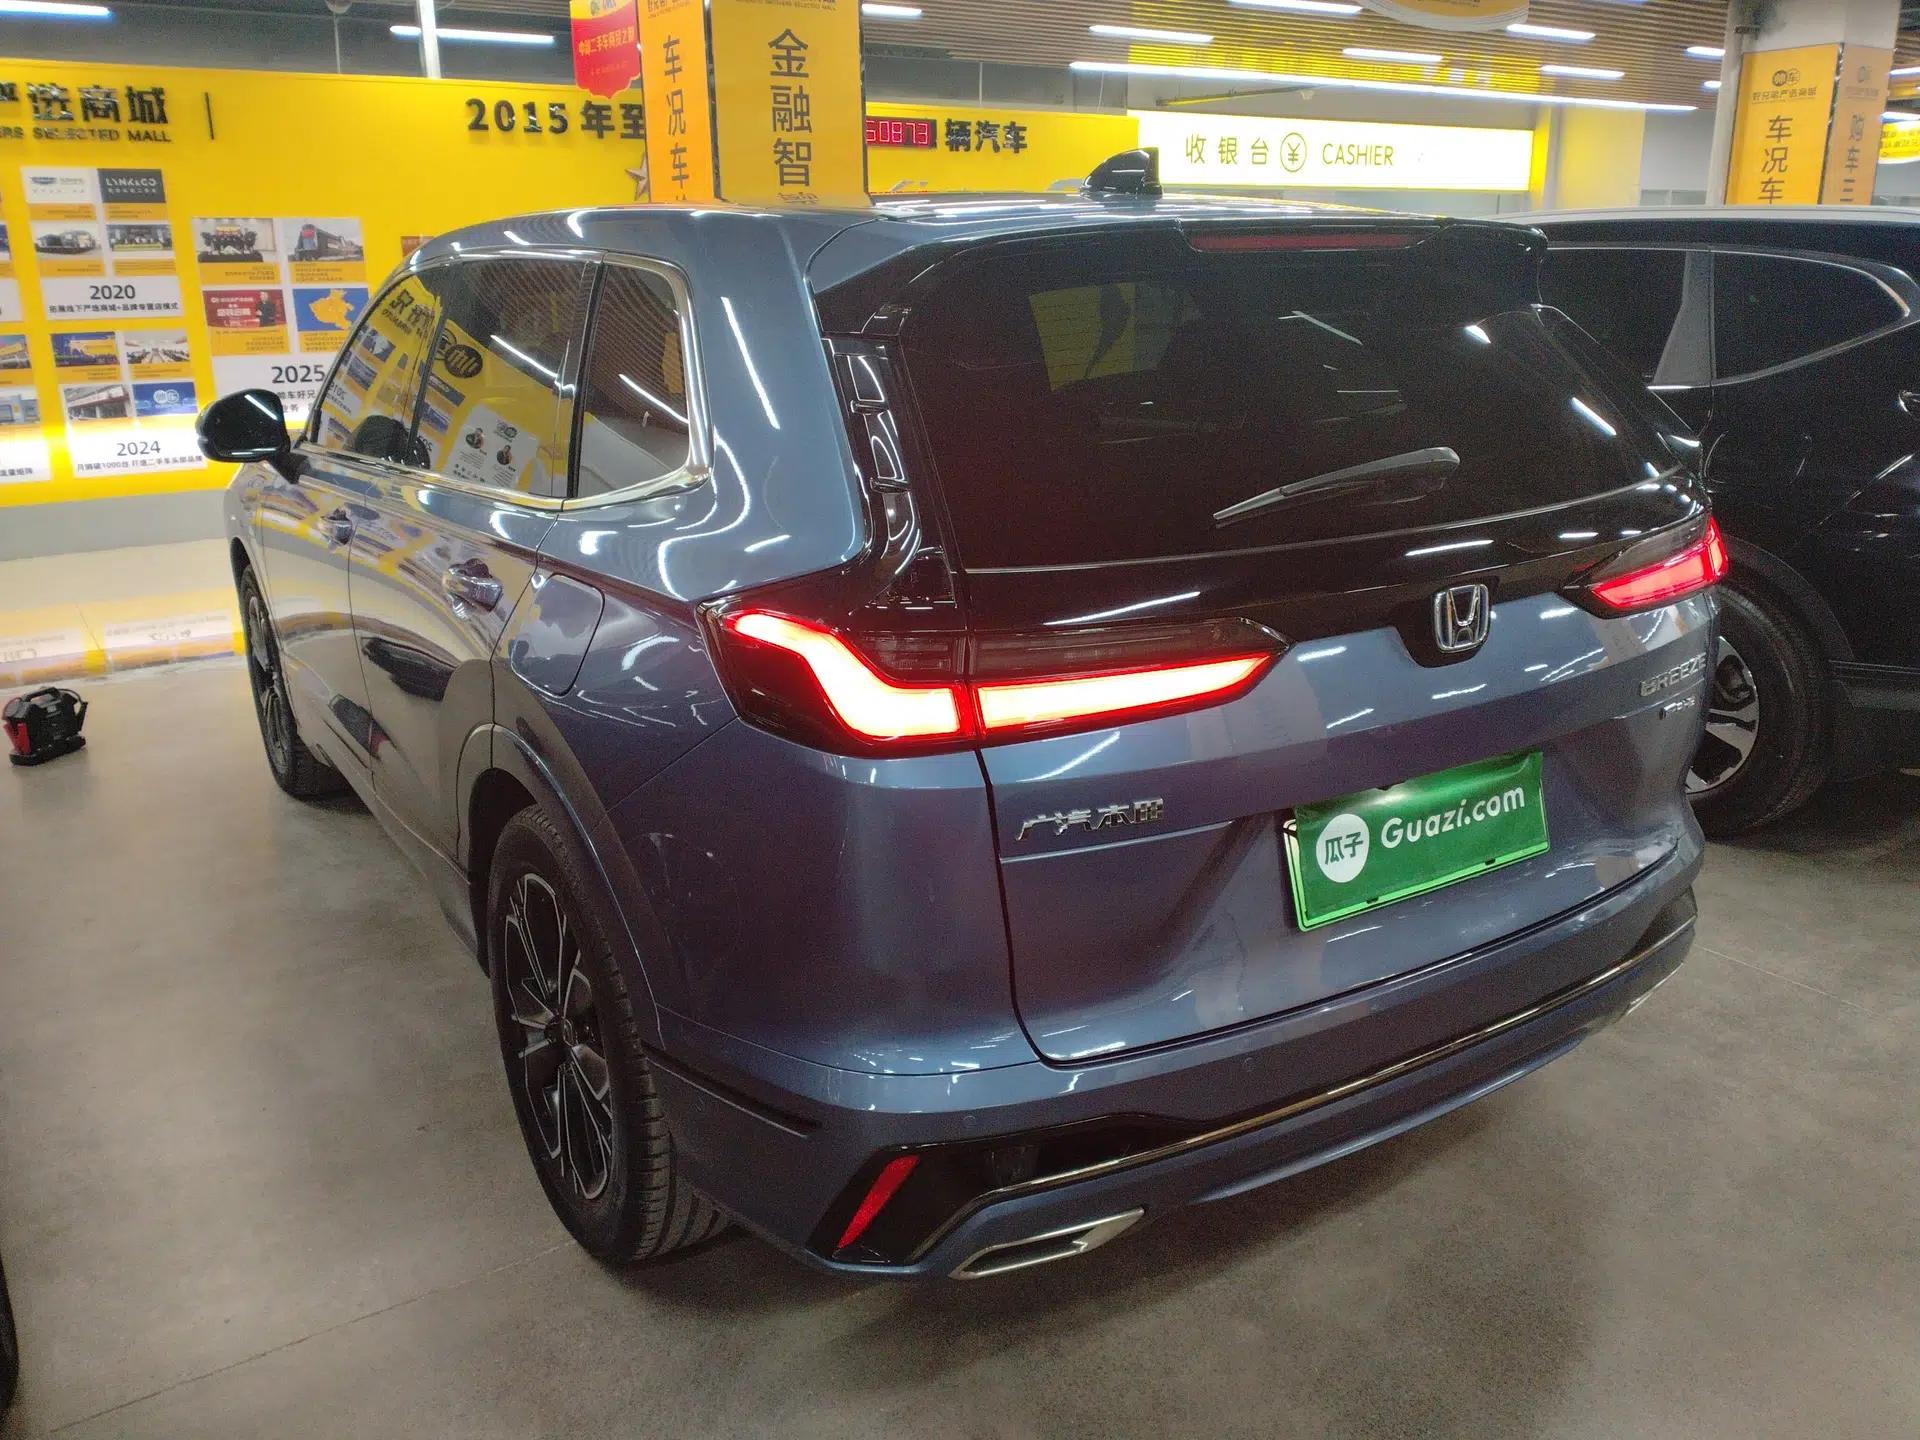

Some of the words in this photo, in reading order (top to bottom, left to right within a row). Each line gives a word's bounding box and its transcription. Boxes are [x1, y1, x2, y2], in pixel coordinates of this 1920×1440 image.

[662, 33, 690, 200] 车况车
[768, 28, 818, 201] 金融智
[0, 126, 24, 139] RS
[33, 127, 120, 141] SELECTED
[127, 129, 172, 142] MALL
[945, 118, 1027, 154] 辆汽车
[1185, 133, 1269, 165] 收银台
[1322, 142, 1393, 167] CASHIER
[90, 284, 136, 300] 2020
[271, 365, 326, 384] 2025
[116, 441, 161, 457] 2024
[1016, 798, 1164, 841] 广汽本田
[1325, 831, 1364, 865] 瓜子
[1380, 787, 1525, 849] Guazi.com
